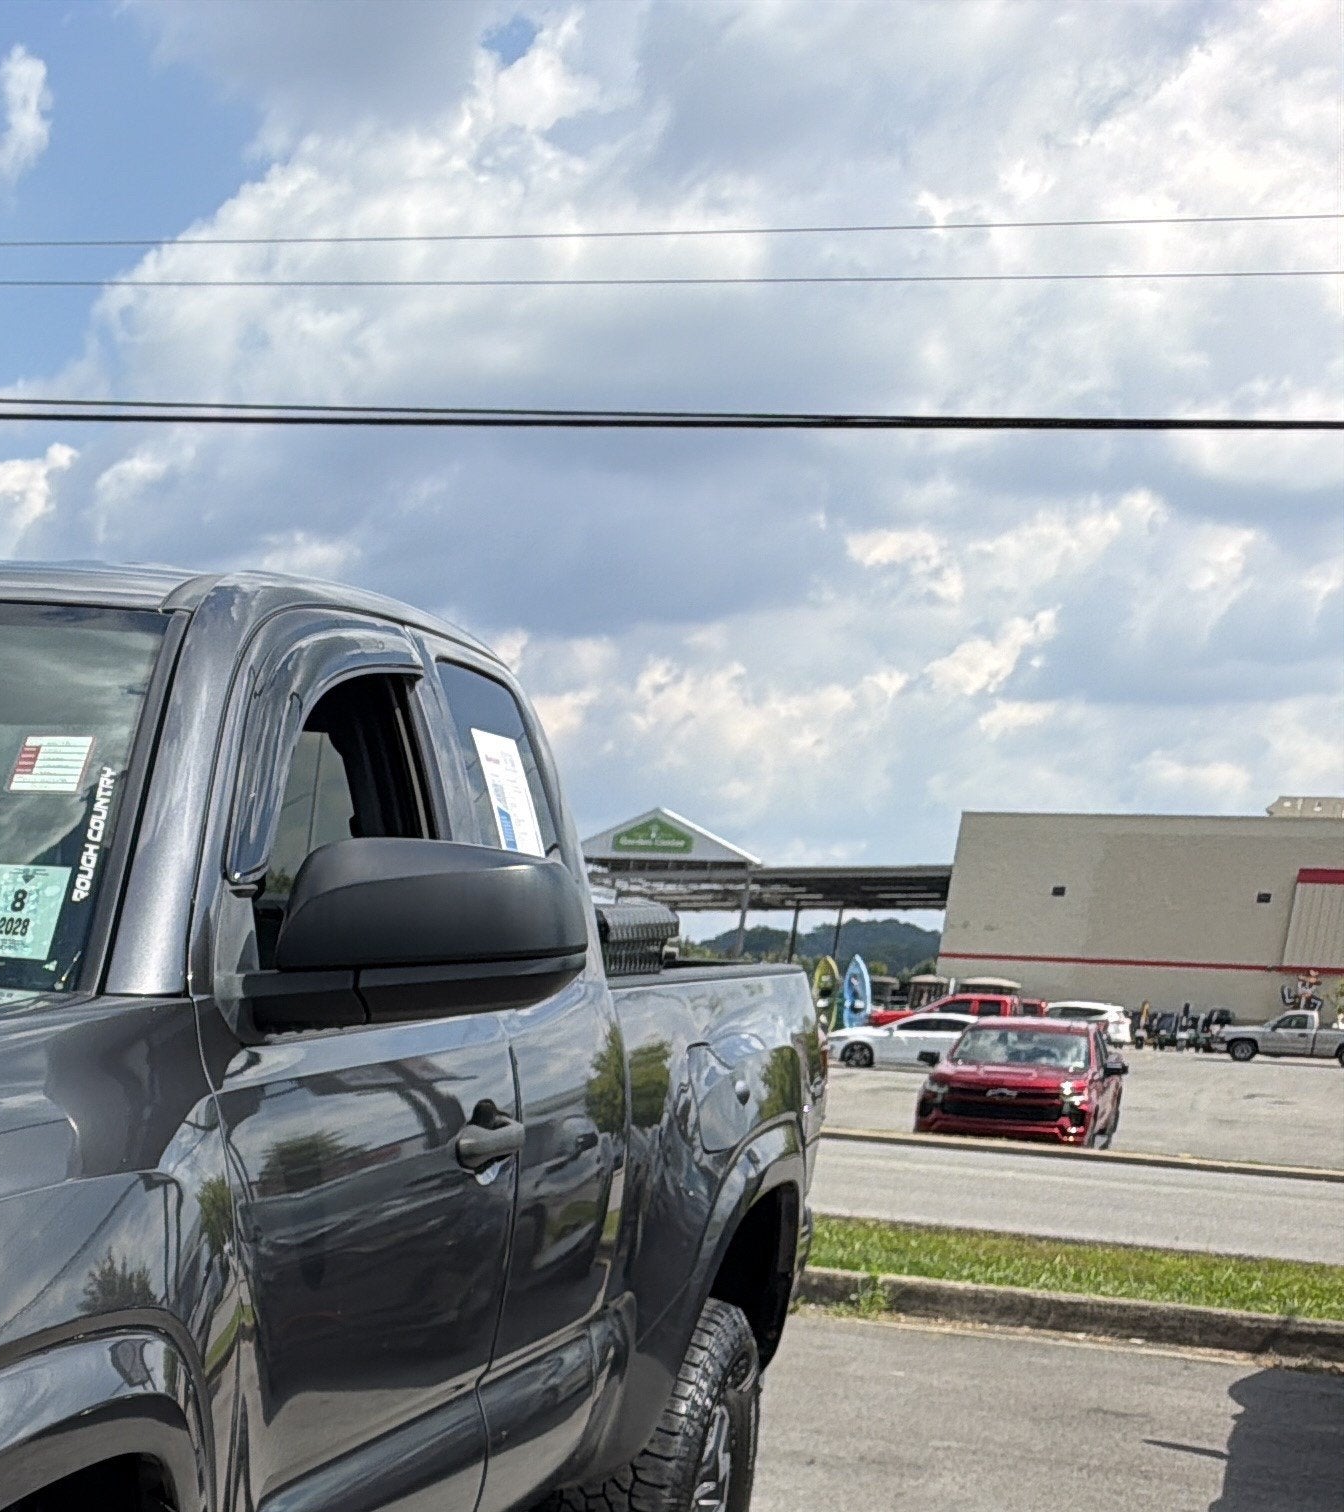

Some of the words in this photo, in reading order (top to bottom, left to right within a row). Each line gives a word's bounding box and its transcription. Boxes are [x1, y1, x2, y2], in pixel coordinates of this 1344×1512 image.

[71, 843, 101, 902] ROUGH
[86, 766, 116, 843] COUNTRY
[10, 889, 29, 913] 8
